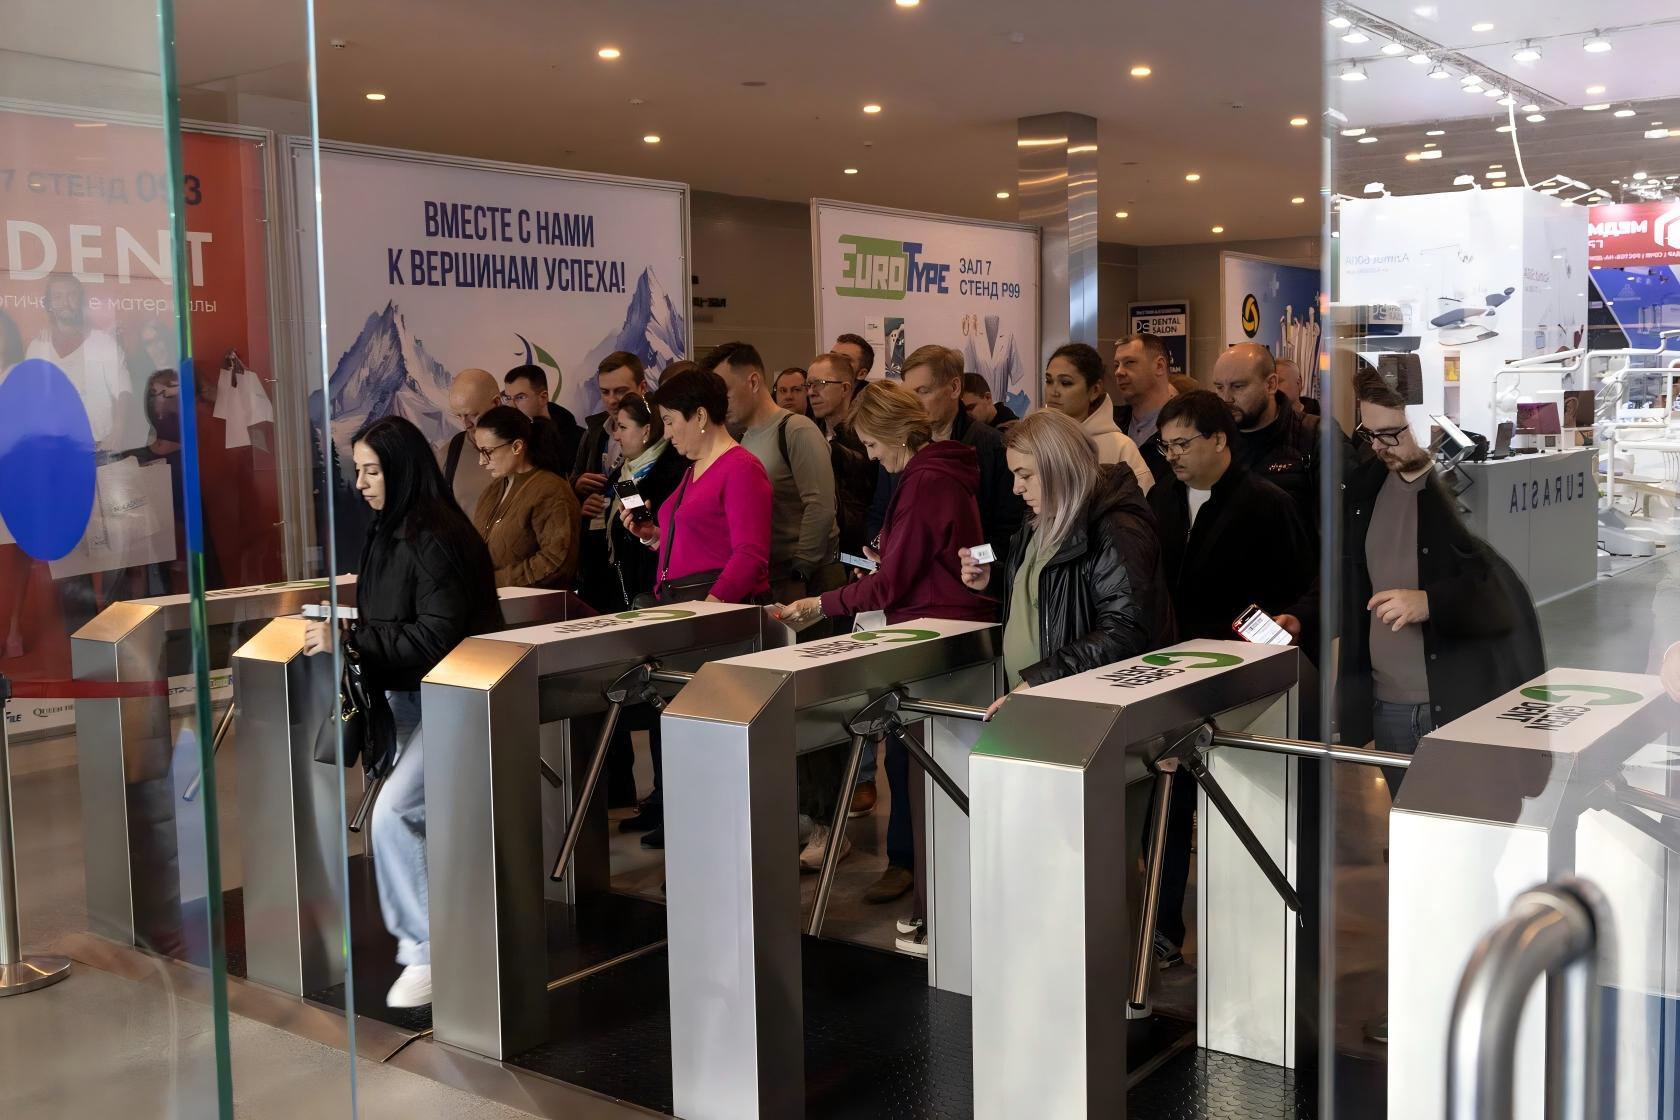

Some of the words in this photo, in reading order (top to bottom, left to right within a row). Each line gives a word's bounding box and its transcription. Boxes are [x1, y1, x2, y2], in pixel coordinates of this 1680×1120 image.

[27, 171, 129, 205] СТЕНД
[424, 200, 513, 243] ВМЕСТЕ
[518, 209, 531, 243] С
[536, 210, 595, 248] НАМИ
[7, 219, 213, 287] DENT
[387, 247, 405, 285] К
[410, 249, 539, 290] ВЕРШИНАМ
[543, 256, 626, 294] УСПЕХА!
[959, 257, 983, 275] ЗАЛ
[985, 260, 992, 275] 7
[959, 279, 999, 299] СТЕНД
[1152, 318, 1181, 326] DENTAL
[1152, 325, 1177, 334] SALON
[1495, 701, 1555, 723] DENT
[1523, 705, 1591, 732] GREEN
